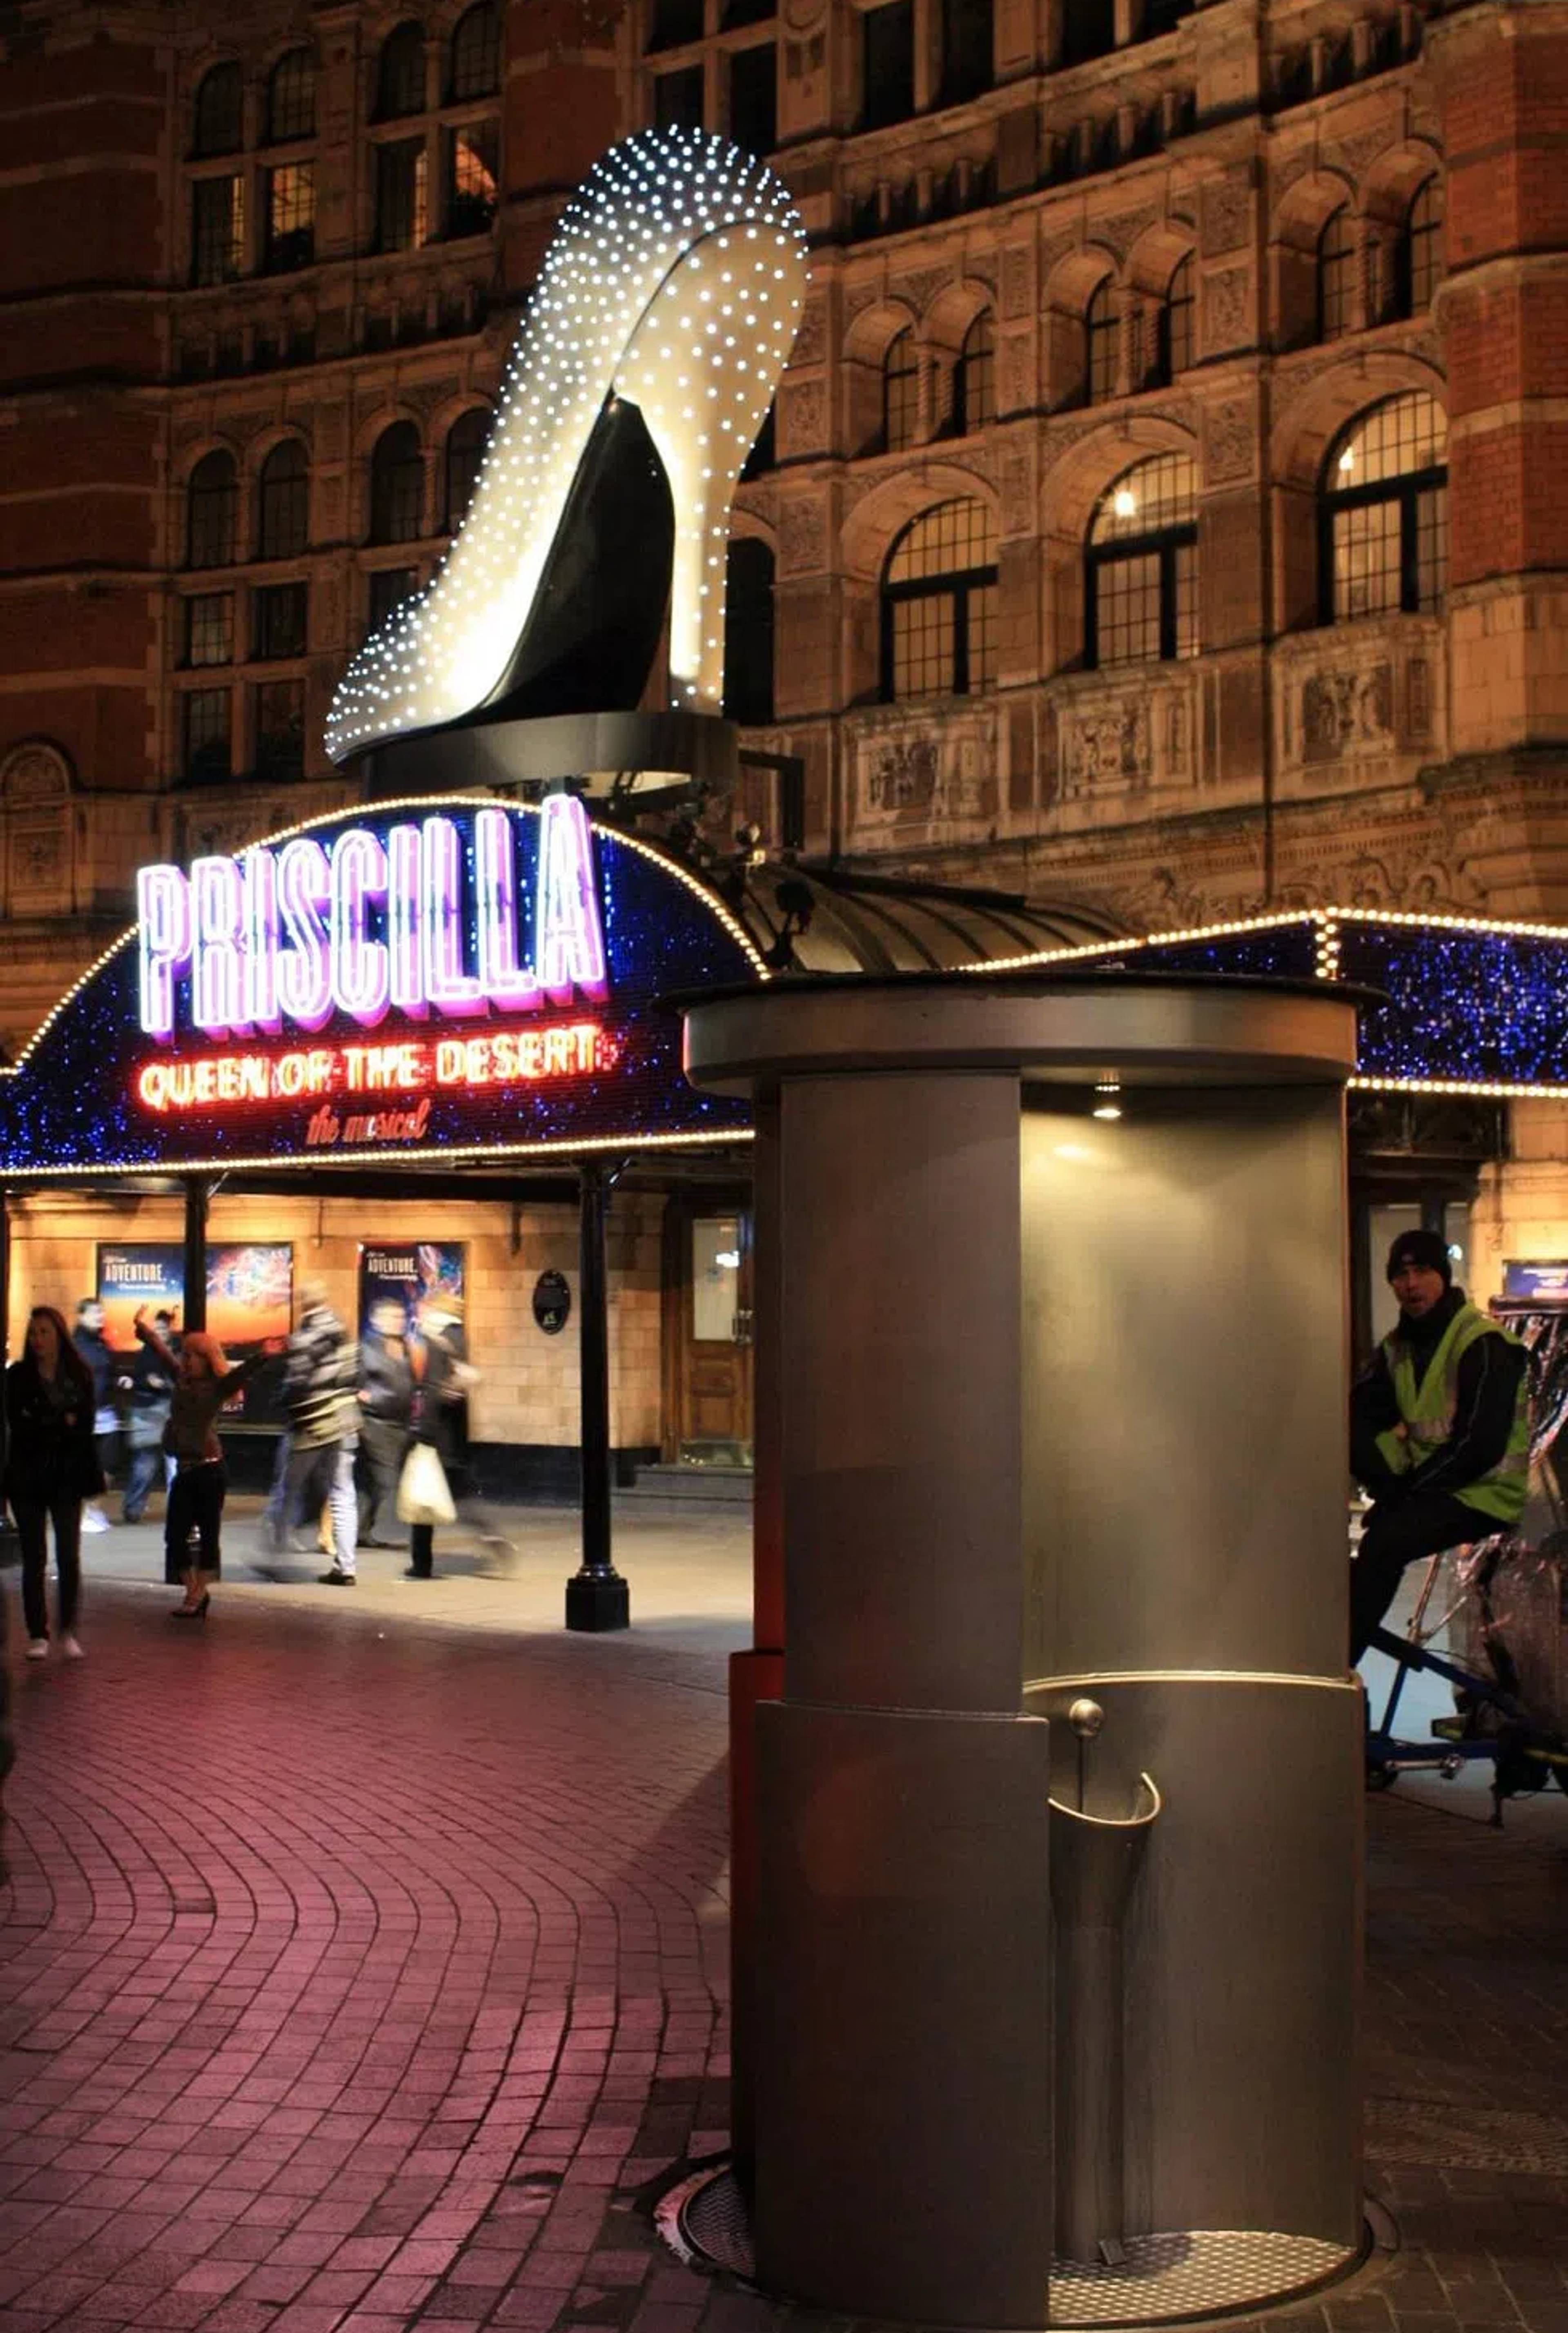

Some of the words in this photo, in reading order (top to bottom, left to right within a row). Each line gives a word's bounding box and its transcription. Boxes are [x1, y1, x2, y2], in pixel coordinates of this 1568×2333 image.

[136, 793, 608, 1039] PRISCILLA
[139, 1058, 270, 1108] QUEEN
[276, 1051, 333, 1098] OF
[342, 1045, 424, 1090] THE
[436, 1025, 602, 1083] DESERT
[306, 1104, 339, 1144] the
[343, 1098, 430, 1141] musical
